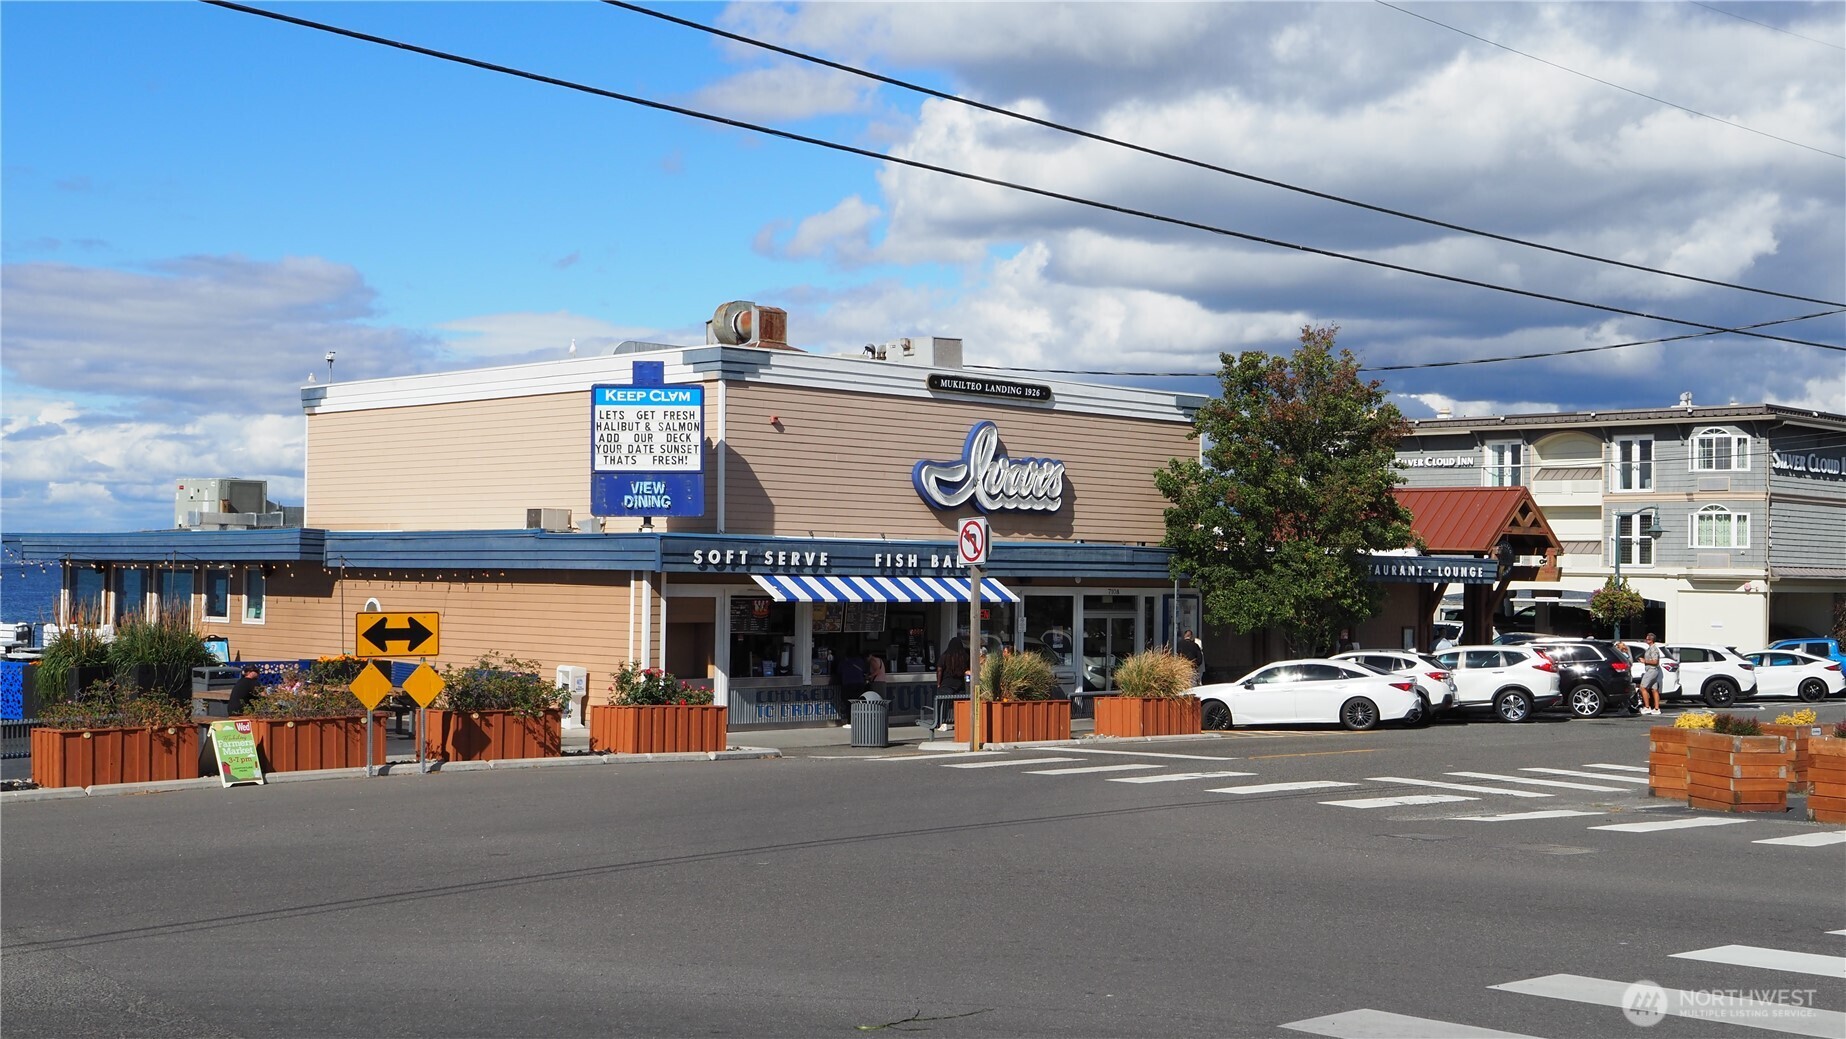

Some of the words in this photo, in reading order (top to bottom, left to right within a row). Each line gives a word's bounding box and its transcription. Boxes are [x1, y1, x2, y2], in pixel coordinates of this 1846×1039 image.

[940, 379, 982, 391] MUKILTEO
[985, 384, 1022, 395] LANDING
[1025, 387, 1040, 397] 1926
[605, 389, 646, 402] KEEP
[599, 410, 625, 420] LETS
[636, 410, 655, 420] GET
[663, 410, 696, 420] FRESH
[596, 421, 640, 432] HALIBUT
[645, 422, 651, 432] &
[658, 421, 700, 432] SALMON
[598, 433, 620, 443] ADD
[633, 433, 653, 443] OUR
[666, 433, 692, 443] DECK
[596, 444, 622, 454] YOUR
[627, 444, 655, 454] DATE
[660, 444, 699, 454] SUNSET
[603, 455, 637, 465] THATS
[652, 455, 688, 465] FRESH!
[1457, 456, 1474, 466] INN
[1807, 453, 1840, 474] CLOUD
[631, 482, 665, 494] VIEW
[624, 495, 672, 509] DINING
[693, 550, 748, 565] SOFT
[764, 552, 829, 567] SERVE
[875, 554, 918, 568] FISH
[1437, 567, 1483, 578] LOUNGE
[236, 723, 250, 731] Wed
[218, 740, 254, 748] Farmers
[222, 747, 254, 755] Market
